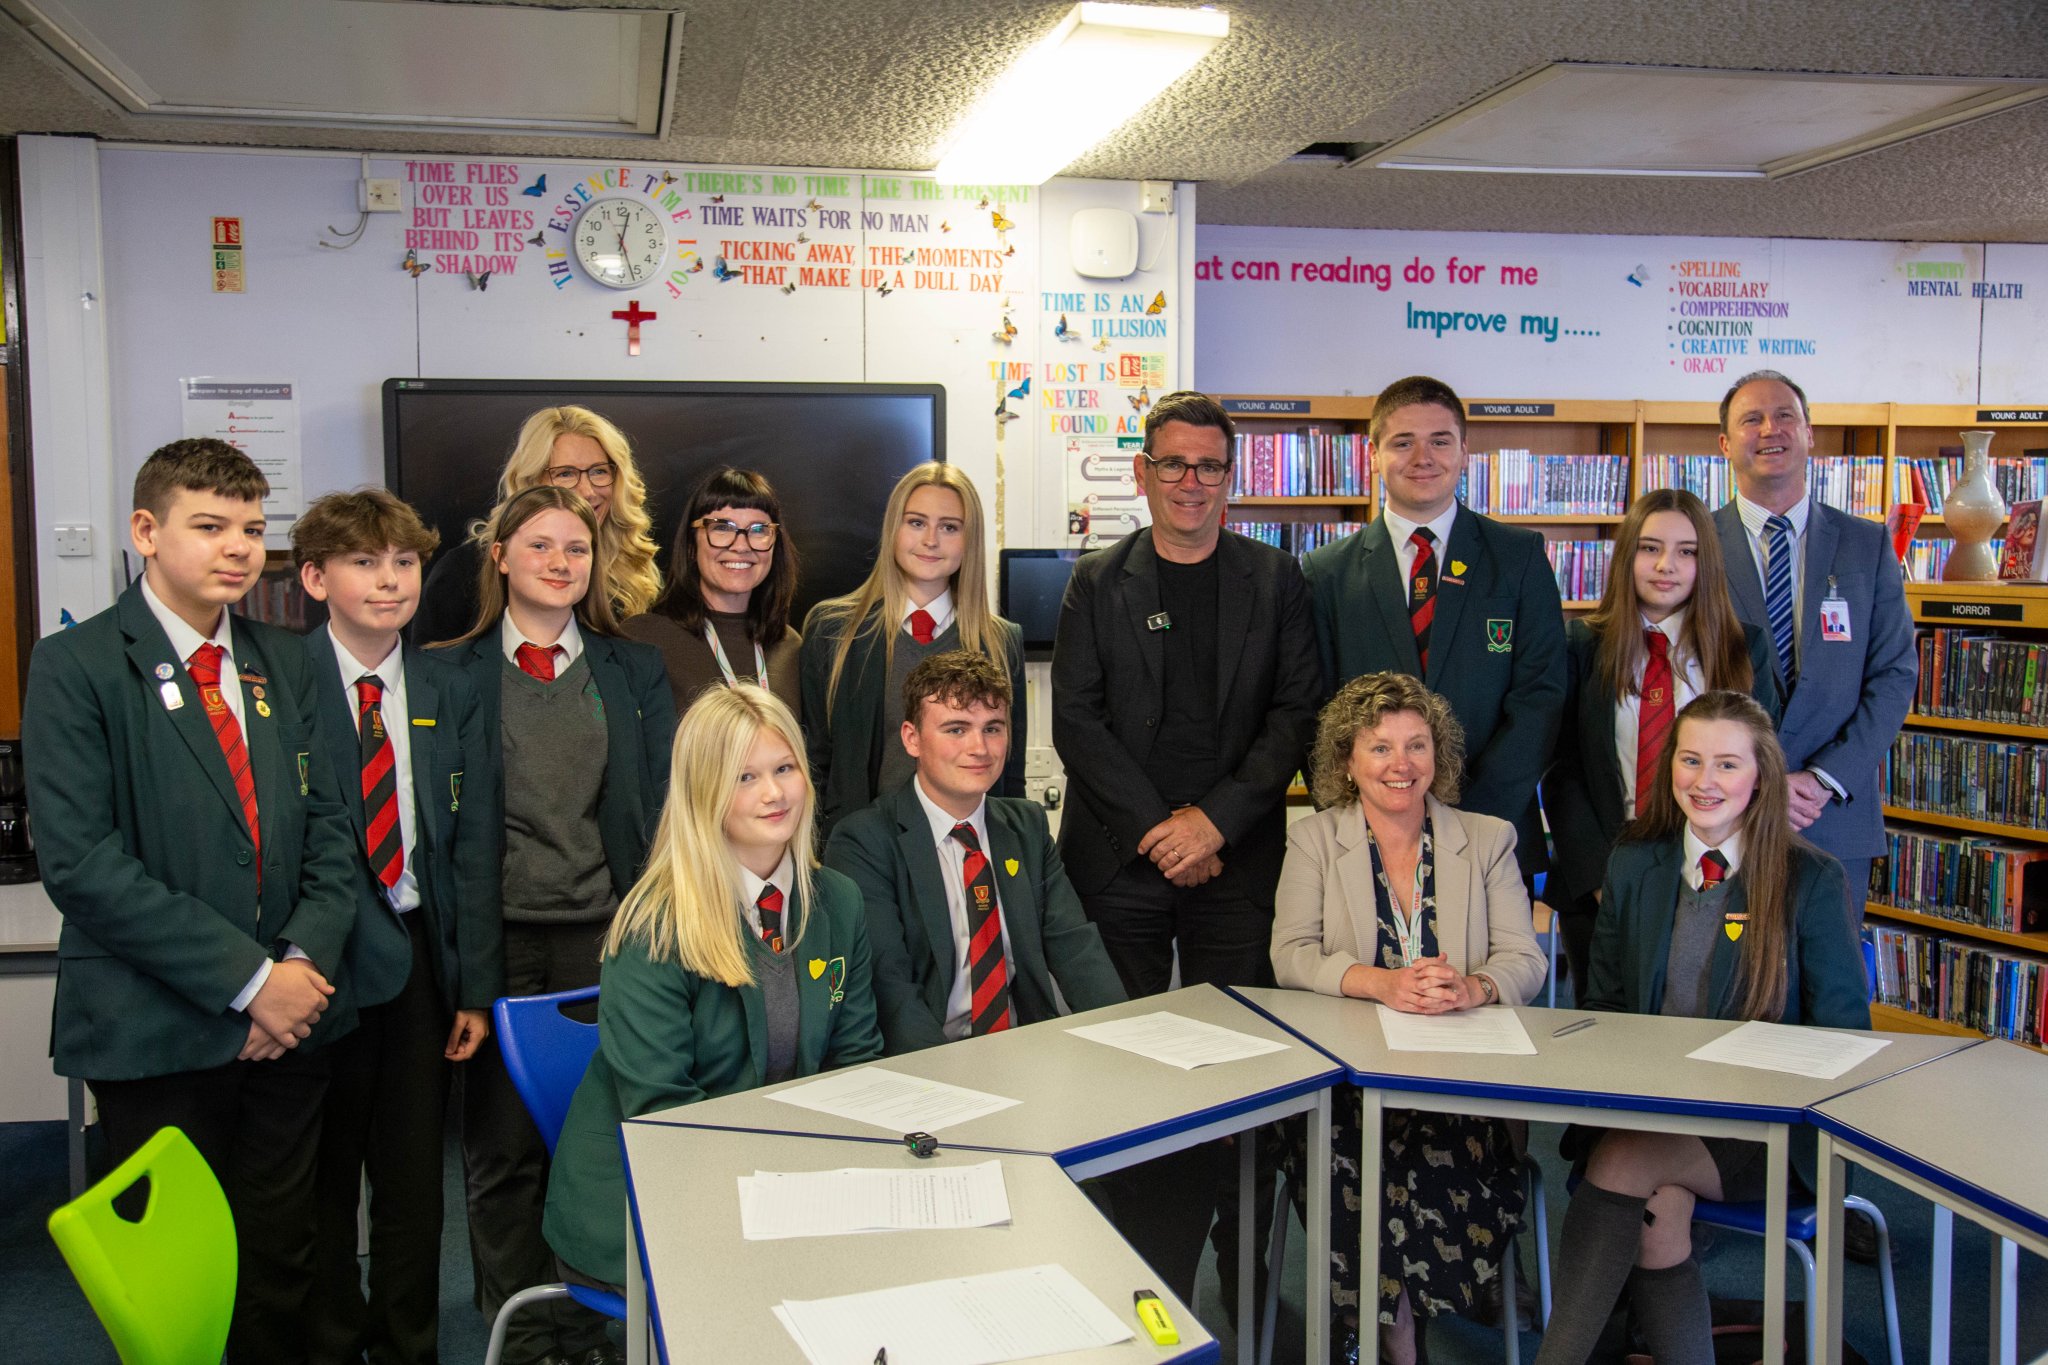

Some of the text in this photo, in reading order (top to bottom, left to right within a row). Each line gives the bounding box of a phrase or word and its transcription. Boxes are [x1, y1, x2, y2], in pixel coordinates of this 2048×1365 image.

[405, 162, 518, 184] TIME FLIES
[423, 185, 509, 206] OVER US
[685, 172, 1031, 202] THERE'S NO TIME LIKE THE PRESENT
[643, 174, 692, 224] TIME
[413, 208, 534, 230] BUT LEAVES
[602, 211, 610, 220] 11
[616, 207, 628, 217] 12
[700, 205, 929, 233] TIME WAITS FOR NO MAN
[589, 221, 602, 231] 10
[645, 223, 654, 234] 2
[405, 229, 524, 252] BEHIND ITS
[586, 236, 595, 246] 9
[648, 239, 657, 249] 3
[644, 254, 651, 264] 4
[678, 239, 698, 263] IS
[721, 240, 1003, 269] TICKING AWAY, THE MOMENTS
[435, 254, 518, 275] SHADOW
[545, 247, 573, 290] THE
[633, 265, 641, 274] 5
[1195, 255, 1538, 291] at can reading do for me
[1679, 261, 1741, 278] SPELLING
[1906, 262, 1966, 279] EMPATHY
[665, 270, 689, 299] OF
[741, 265, 787, 285] THAT
[799, 267, 850, 288] MAKE
[860, 269, 884, 289] UP
[893, 270, 905, 289] A
[914, 271, 959, 291] DULL
[1678, 282, 1768, 299] VOCABULARY
[1908, 281, 2023, 299] MENTAL HEALTH
[1042, 292, 1144, 313] TIME IS AN
[1680, 302, 1789, 319] COMPREHENSION
[1406, 302, 1507, 338] Improve
[1678, 321, 1753, 337] COGNITION
[1682, 338, 1816, 356] CREATIVE WRITING
[988, 361, 1116, 382] TIME LOST IS
[1683, 357, 1727, 373] ORACY
[1043, 389, 1099, 408] NEVER
[1237, 401, 1296, 411] YOUNG ADULT
[1484, 405, 1540, 414] YOUNG ADULT
[1990, 412, 2043, 420] YOUNG ADULT
[1051, 415, 1146, 434] FOUND AGA
[1952, 605, 1991, 616] HORROR
